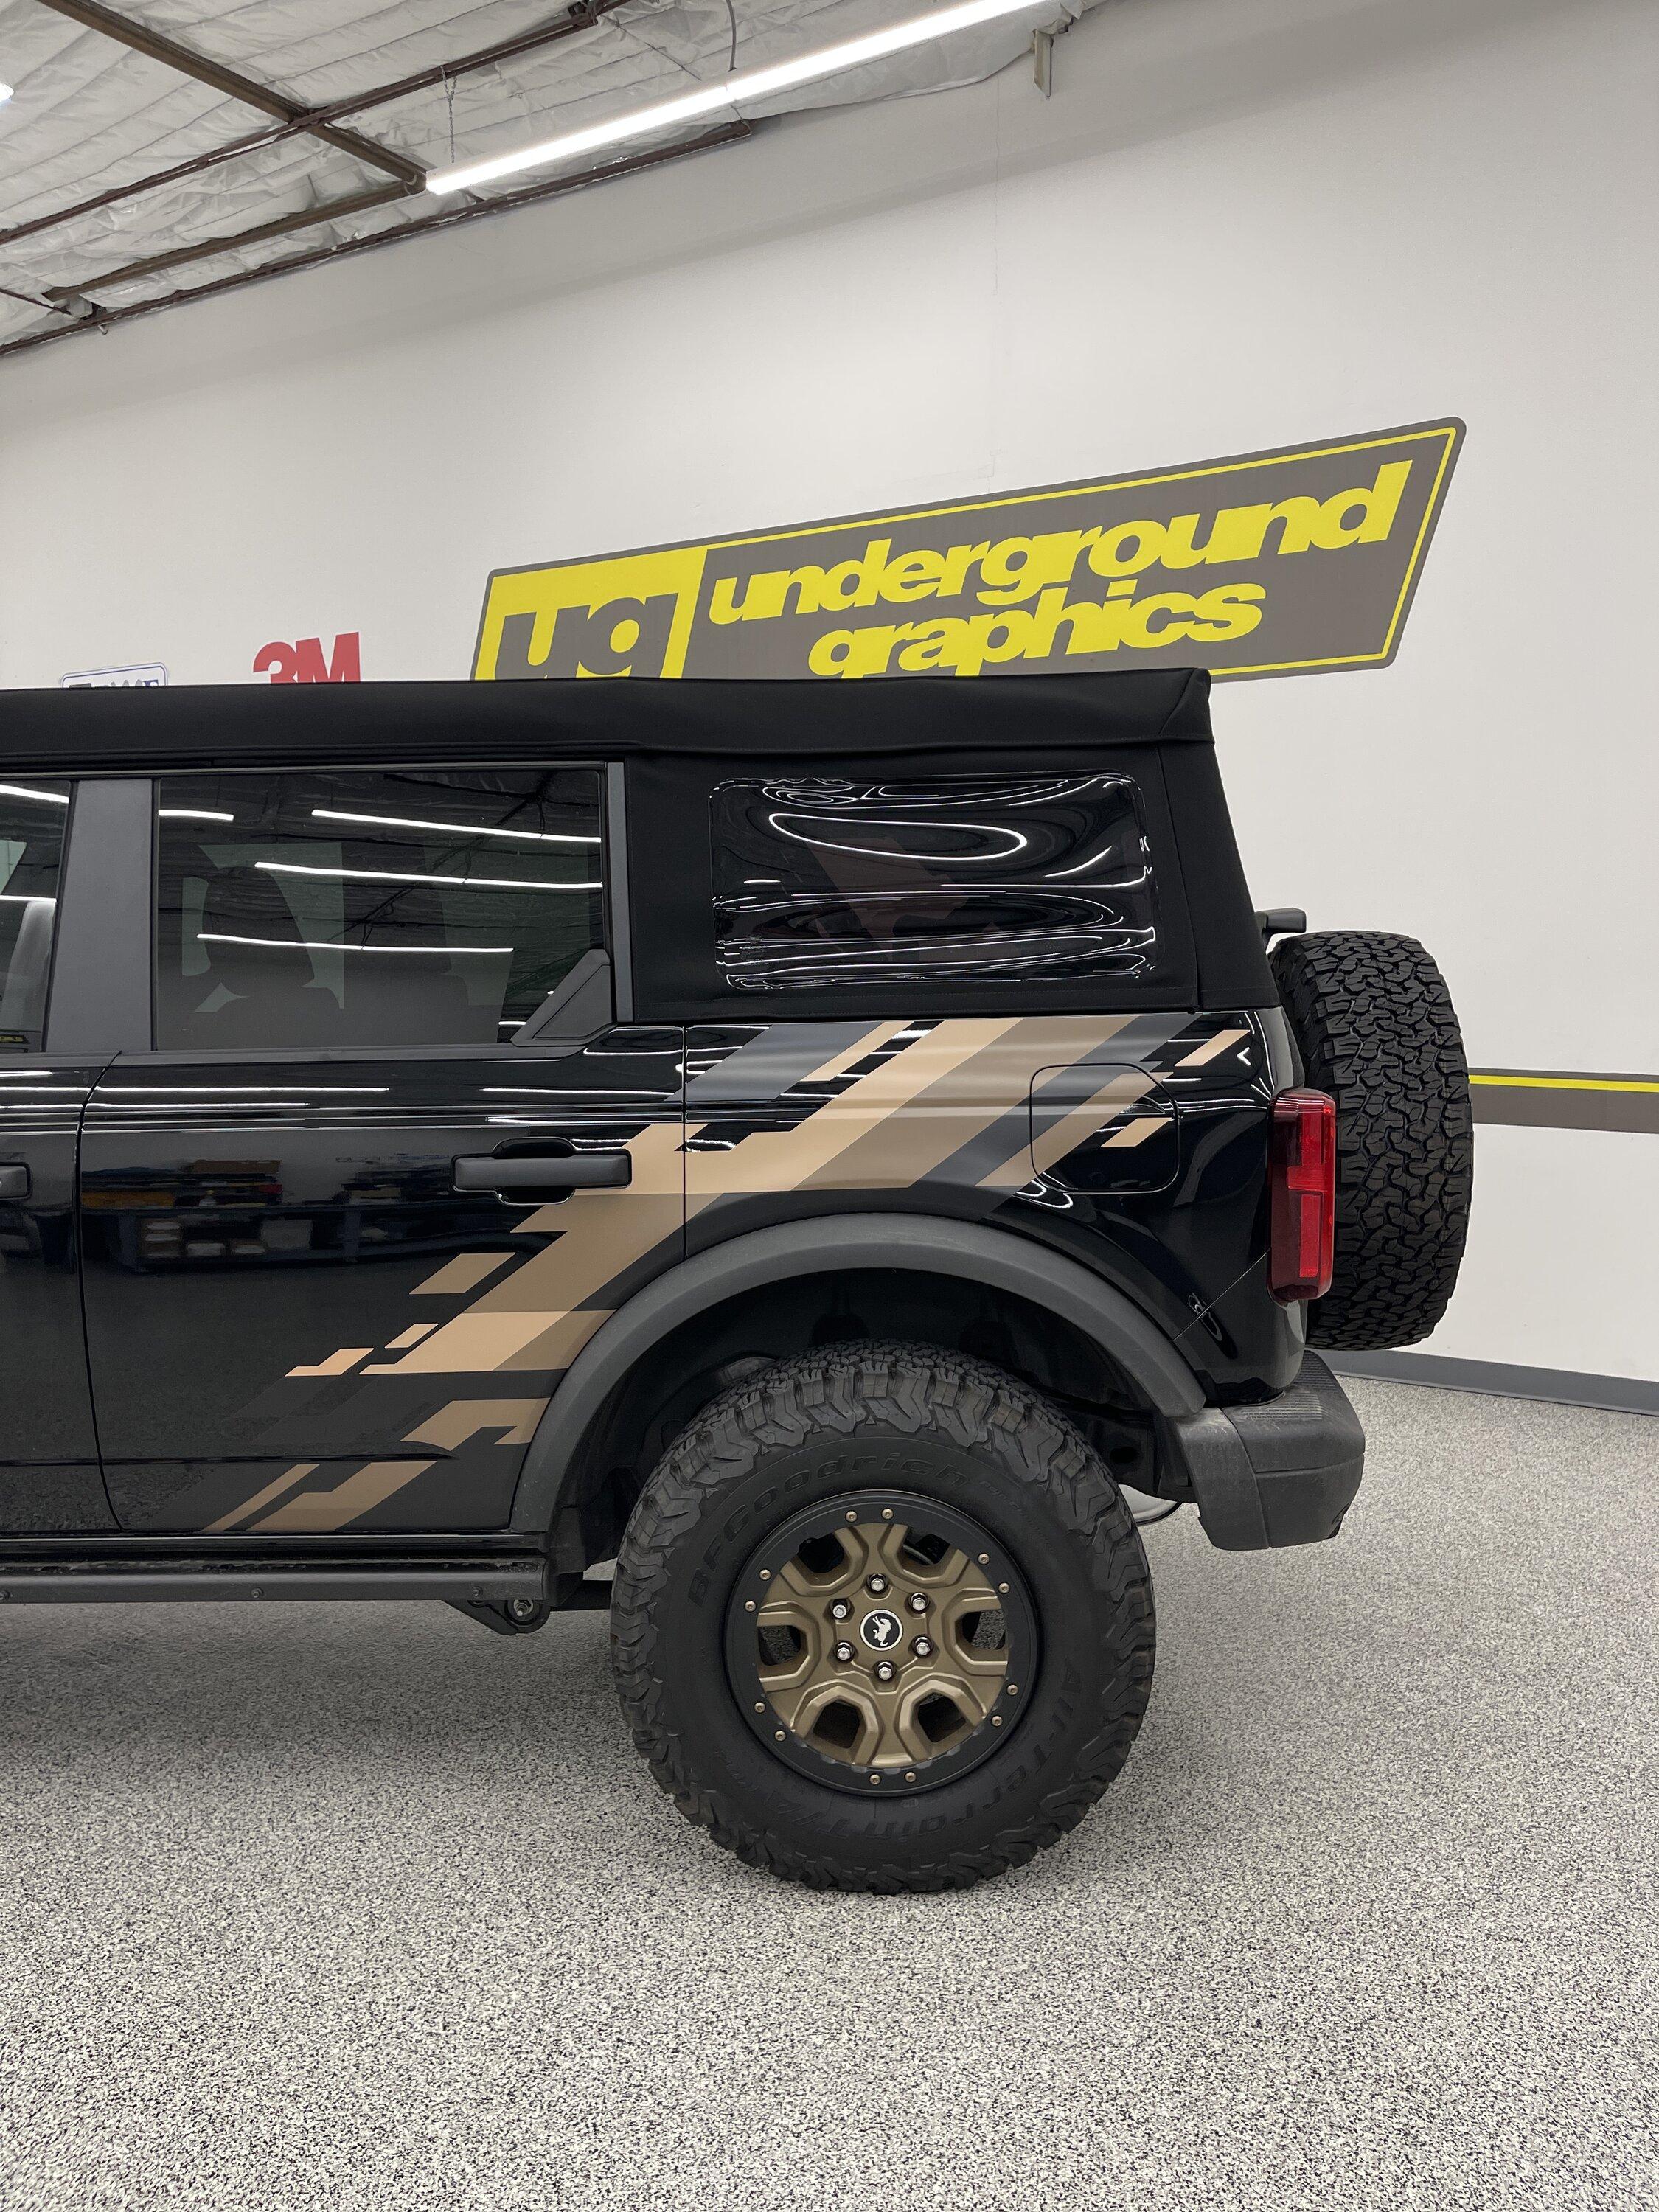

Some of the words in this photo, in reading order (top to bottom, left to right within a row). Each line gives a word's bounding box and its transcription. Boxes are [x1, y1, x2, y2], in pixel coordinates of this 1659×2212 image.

[709, 459, 1412, 625] underground
[253, 632, 361, 684] 3M
[807, 579, 1266, 677] graphics
[687, 1453, 970, 1607] BFGoodrich
